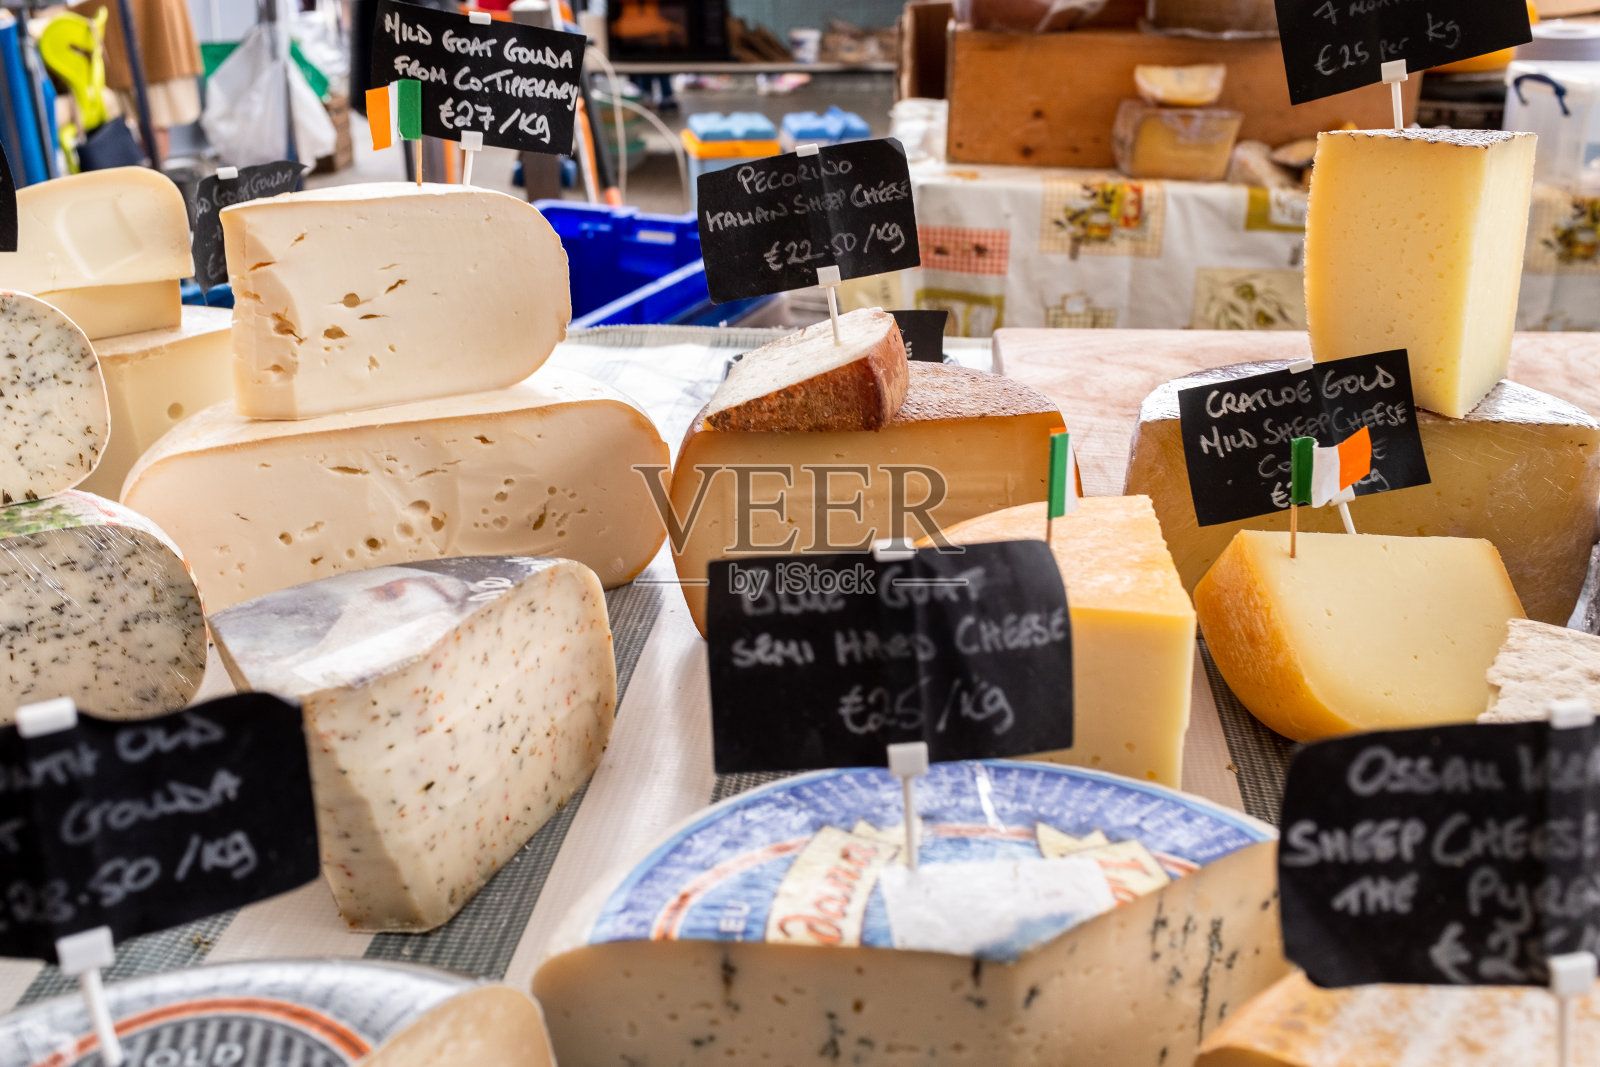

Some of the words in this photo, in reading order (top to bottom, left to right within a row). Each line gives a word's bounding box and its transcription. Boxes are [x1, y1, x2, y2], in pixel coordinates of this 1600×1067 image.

[384, 12, 432, 45] MILD
[442, 29, 497, 58] GOAT
[503, 37, 573, 69] GOUDA
[1313, 41, 1370, 76] €25
[1425, 12, 1462, 49] kg
[394, 55, 448, 86] FROM
[438, 97, 496, 132] €27
[736, 159, 853, 195] PECORINO
[793, 188, 847, 216] SHEEP
[850, 178, 910, 208] CHEESE
[763, 232, 857, 272] €22.50
[1205, 379, 1313, 419] CRATLOE
[1321, 365, 1396, 399] GOLD
[1200, 425, 1258, 458] MILD
[1262, 411, 1330, 446] SHEEP
[1331, 401, 1408, 433] CHEESE
[731, 633, 816, 668] SEMI
[833, 628, 937, 667] HARD
[953, 609, 1068, 656] CHEESE
[1279, 817, 1428, 868] SHEEP
[1331, 872, 1420, 917] THE
